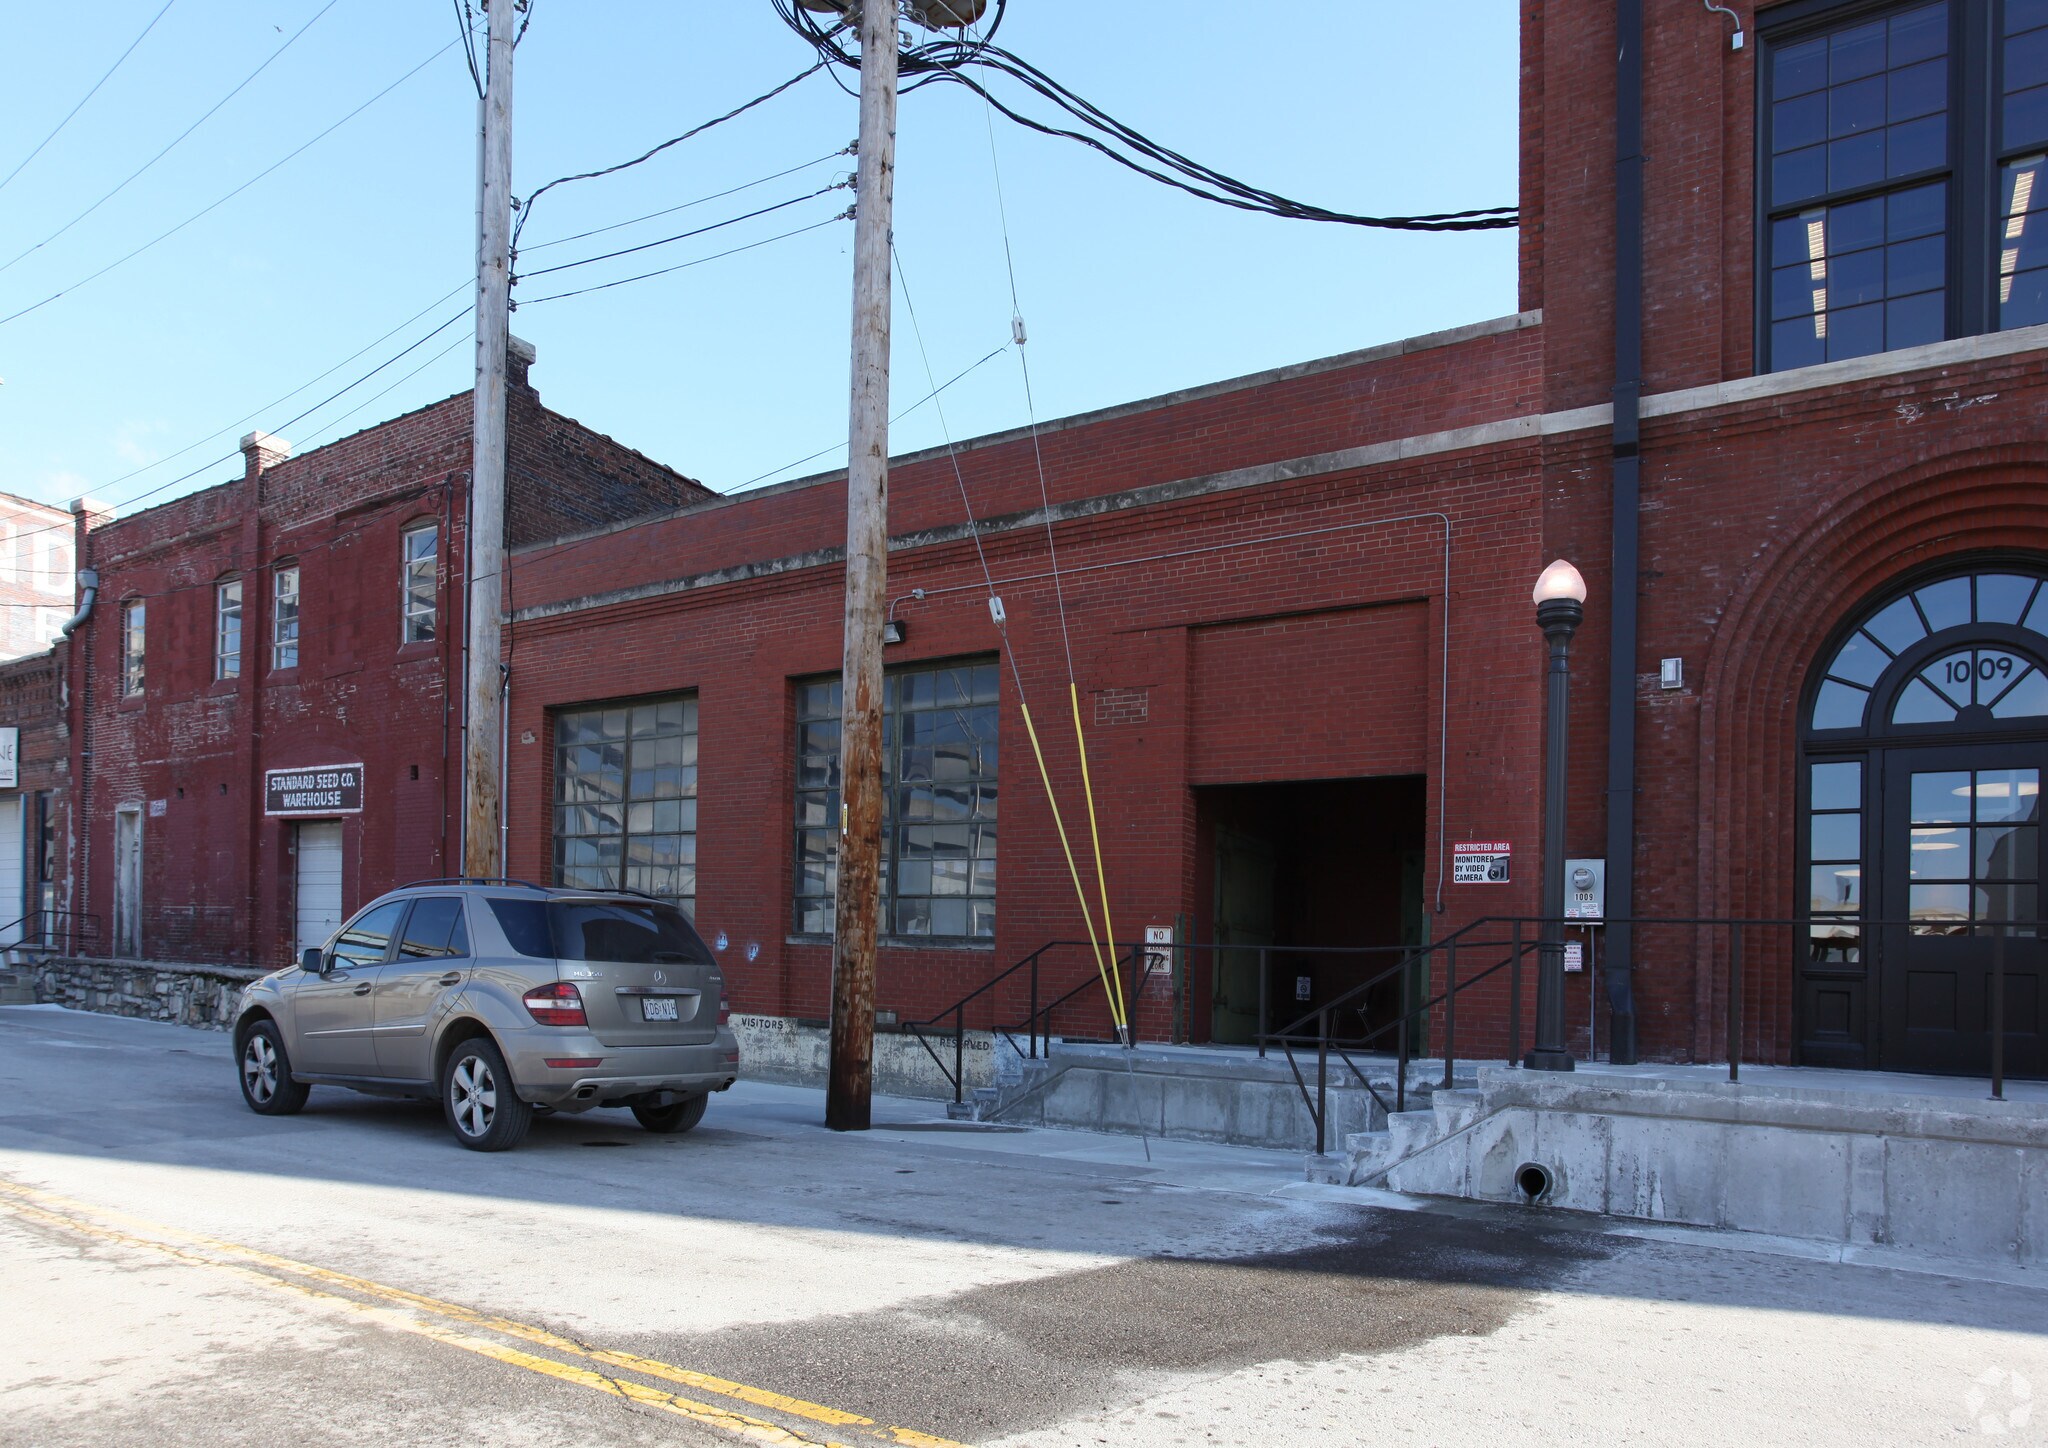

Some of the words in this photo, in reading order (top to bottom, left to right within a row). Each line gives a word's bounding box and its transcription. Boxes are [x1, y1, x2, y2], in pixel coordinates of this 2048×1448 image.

[1945, 656, 2013, 684] 1009
[271, 775, 315, 791] STANDARD
[316, 773, 339, 789] SEED
[341, 772, 356, 787] CO.
[282, 791, 341, 807] WAREHOUSE
[1454, 843, 1492, 852] RESTRICTED
[1493, 842, 1510, 851] AREA
[1455, 855, 1495, 864] MONITORED
[1465, 864, 1485, 872] VIDEO
[1455, 873, 1483, 881] CAMERA
[1575, 893, 1593, 901] 1009
[1153, 930, 1164, 940] NO
[741, 1017, 784, 1030] VISITORS
[940, 1037, 990, 1051] RESRVED
